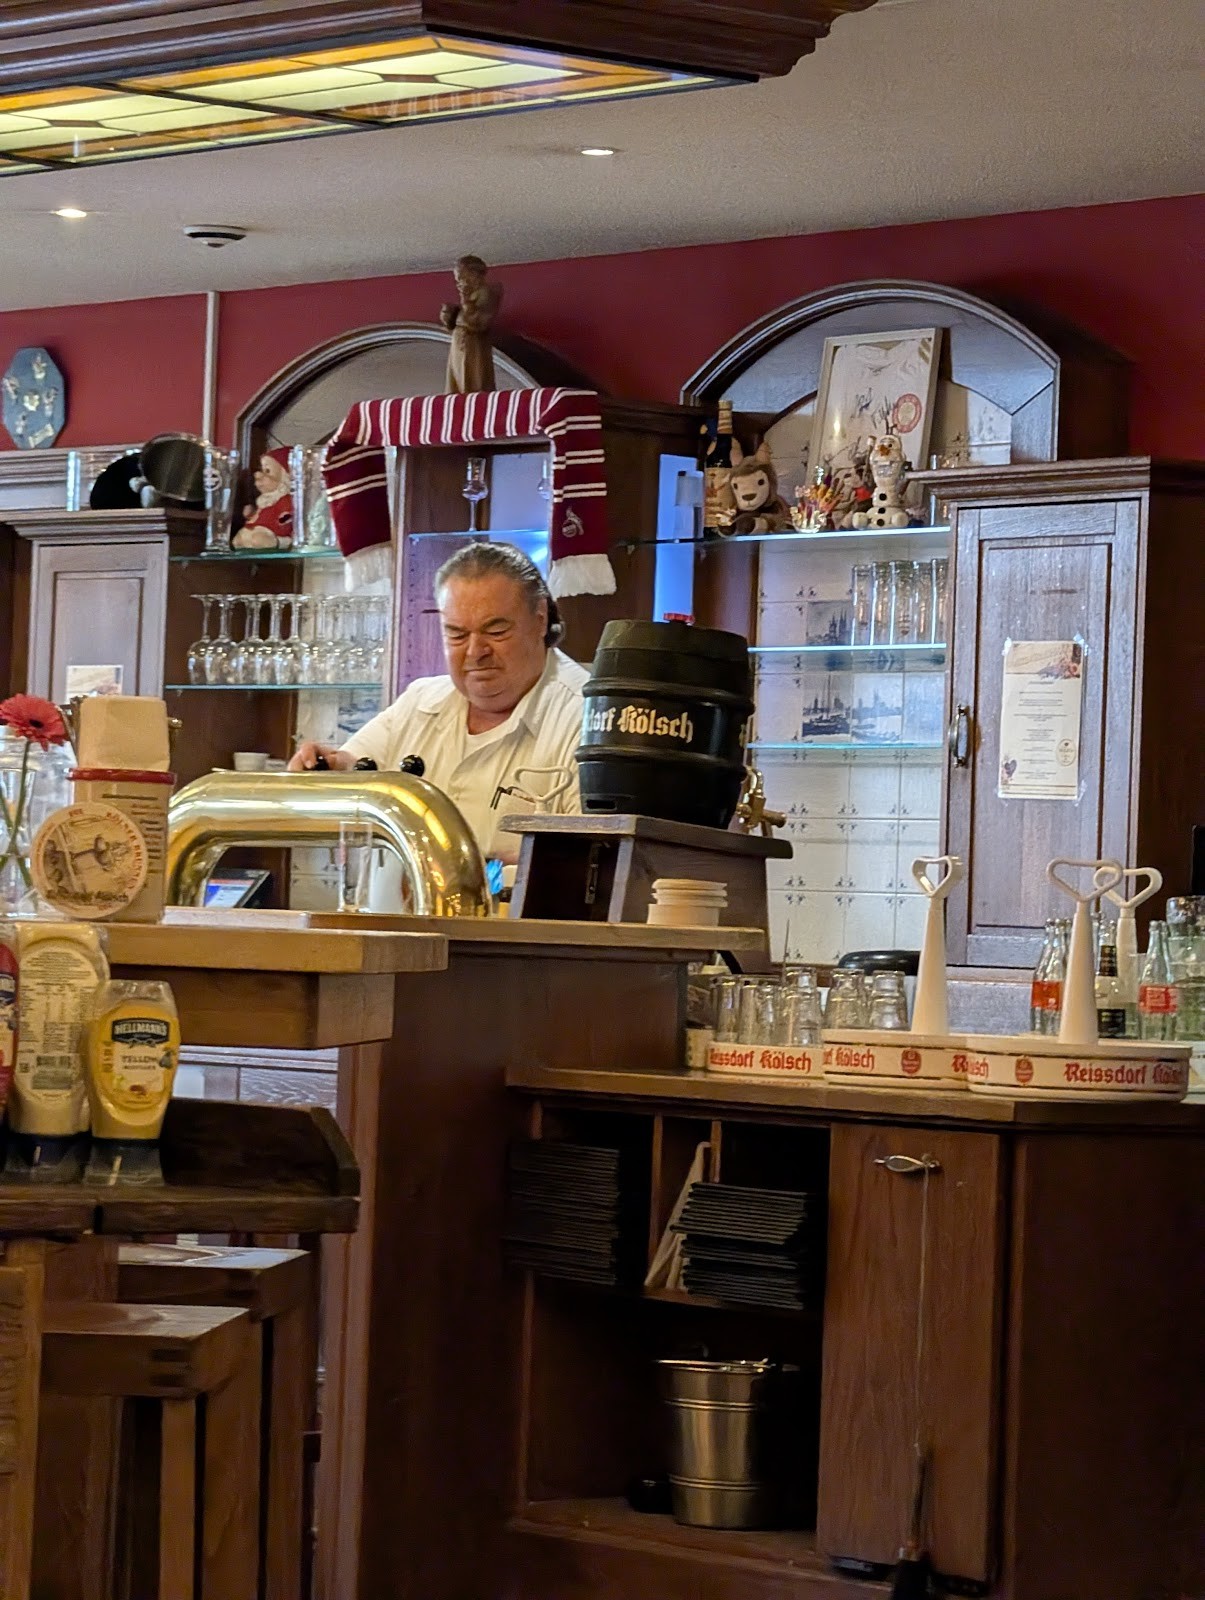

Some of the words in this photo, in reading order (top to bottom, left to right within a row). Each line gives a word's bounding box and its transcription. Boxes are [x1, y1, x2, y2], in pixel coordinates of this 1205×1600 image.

[617, 705, 694, 743] Kölsch
[759, 1050, 812, 1074] Kölsch
[836, 1047, 875, 1072] Kölsch
[1064, 1062, 1147, 1084] Reissdorf
